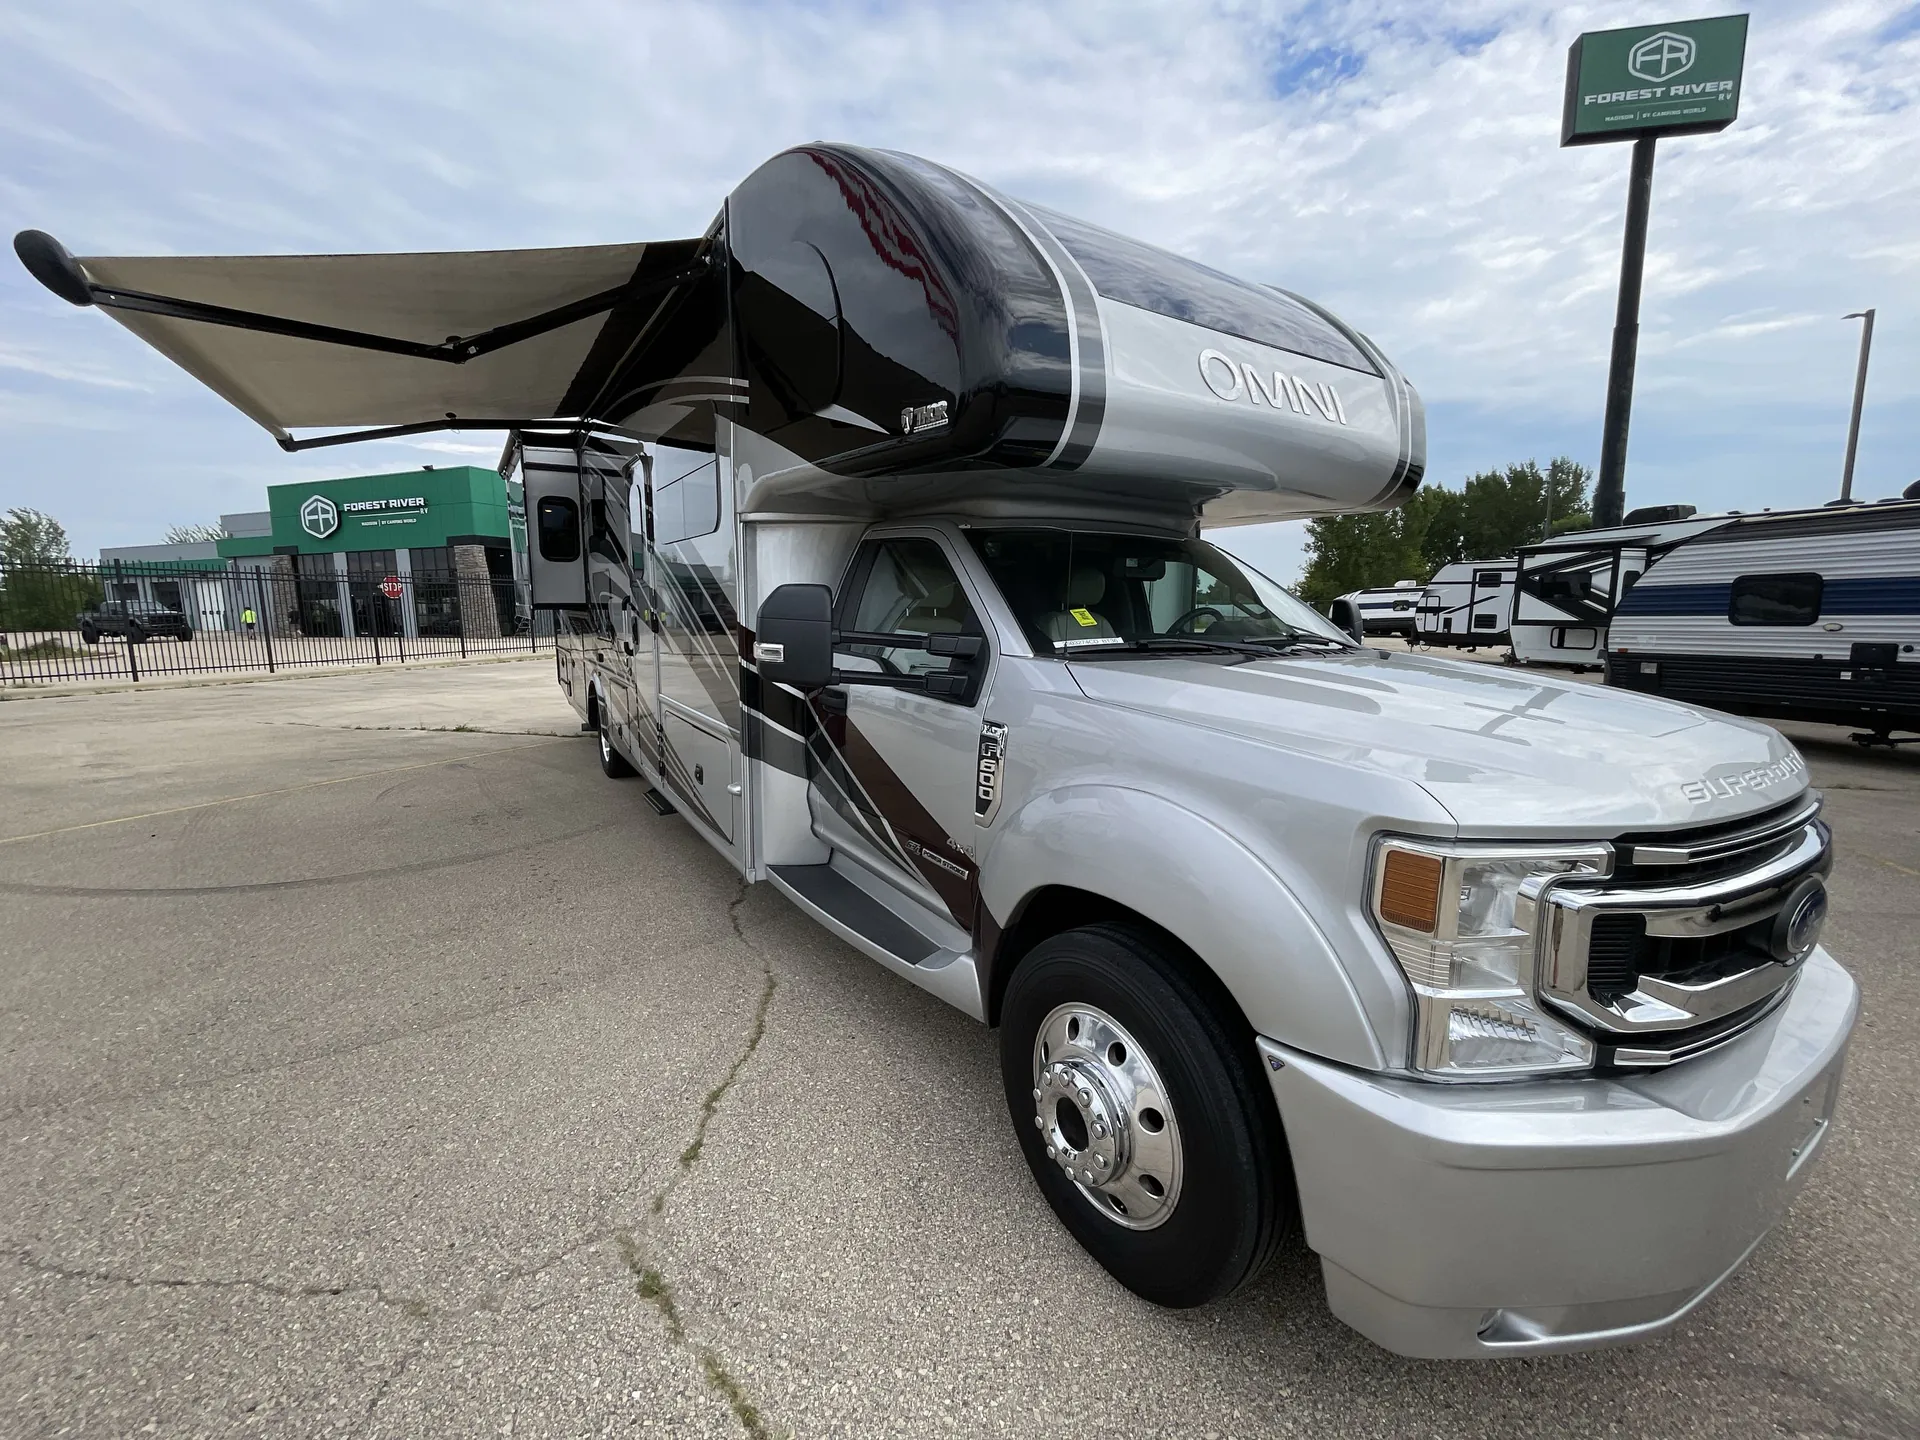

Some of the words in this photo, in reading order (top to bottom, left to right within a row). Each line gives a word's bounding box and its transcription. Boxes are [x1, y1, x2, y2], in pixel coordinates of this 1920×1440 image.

[1584, 87, 1666, 106] FOREST
[1669, 80, 1734, 97] RIVER
[1605, 114, 1634, 122] MADISON
[1683, 106, 1707, 115] WORLD
[1198, 348, 1347, 425] OMNI
[913, 400, 948, 426] THOR
[343, 500, 387, 512] FOREST
[388, 497, 425, 508] RIVER
[383, 582, 402, 592] STOP
